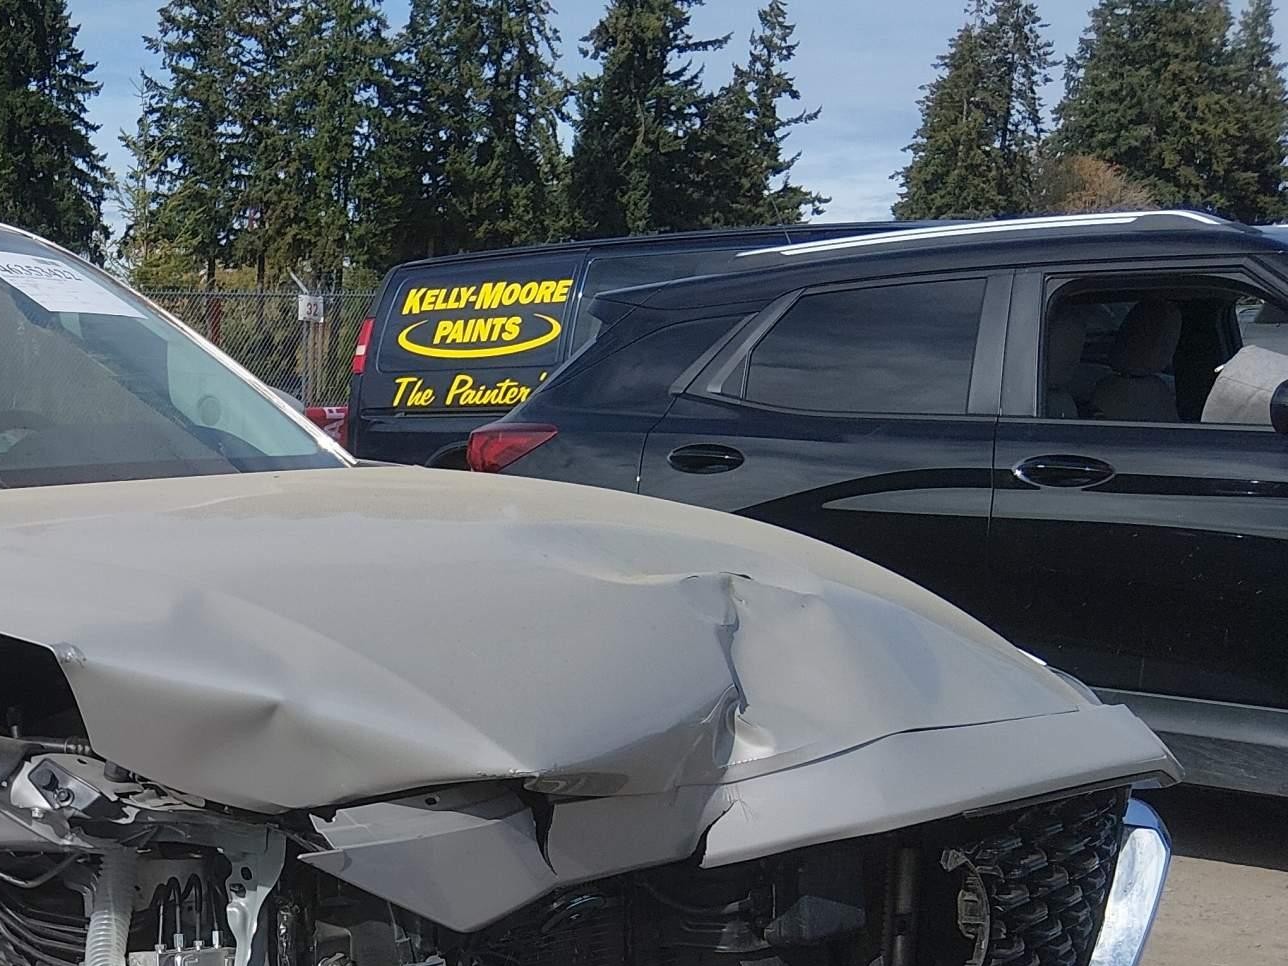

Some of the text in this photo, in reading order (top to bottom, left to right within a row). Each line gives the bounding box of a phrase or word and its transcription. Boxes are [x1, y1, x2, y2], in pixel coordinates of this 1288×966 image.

[306, 302, 318, 317] 32
[403, 280, 573, 315] KELLY-MOORE
[432, 316, 522, 345] PAINTS
[392, 377, 435, 407] The
